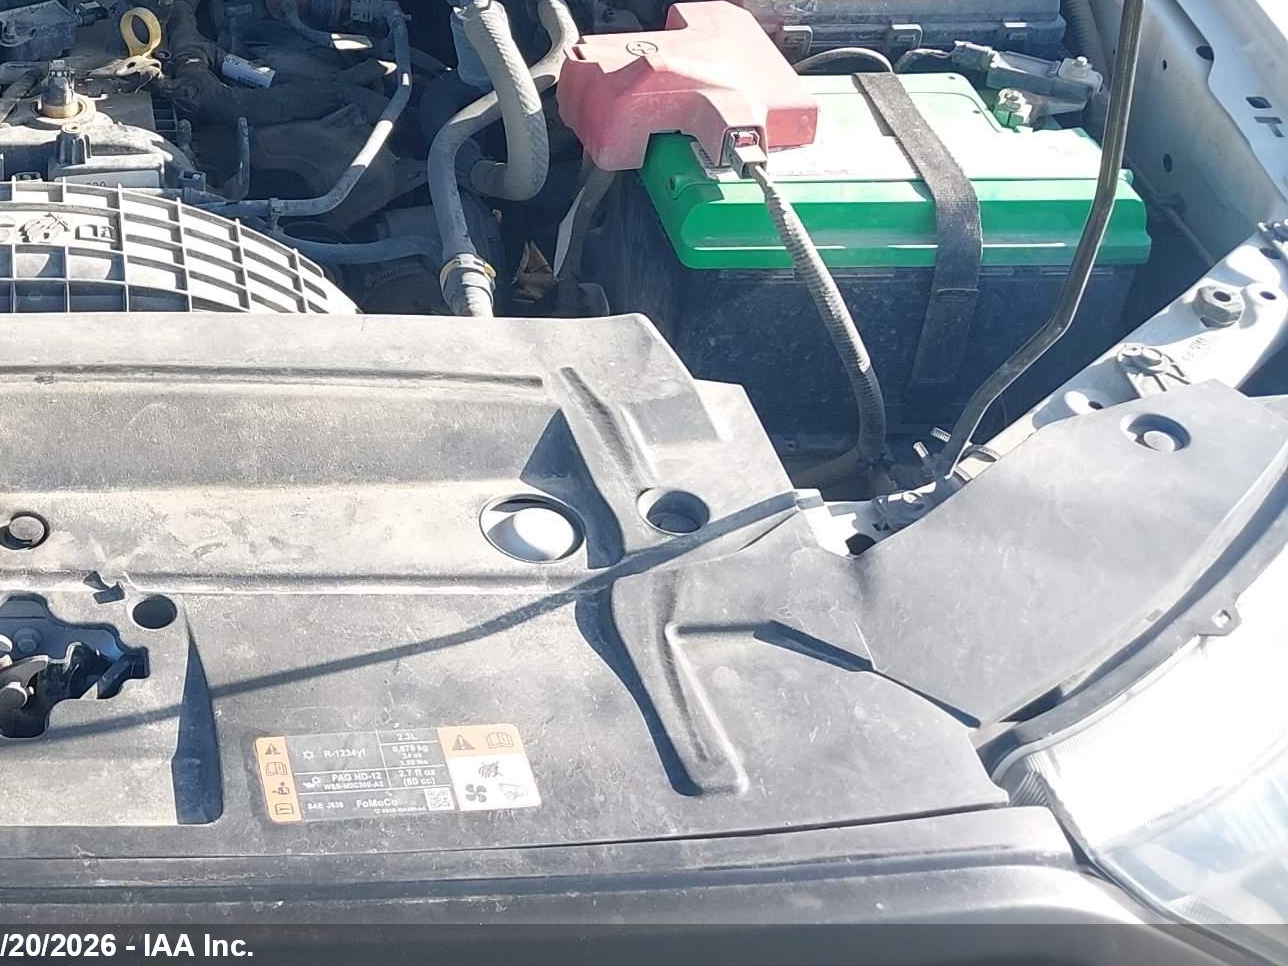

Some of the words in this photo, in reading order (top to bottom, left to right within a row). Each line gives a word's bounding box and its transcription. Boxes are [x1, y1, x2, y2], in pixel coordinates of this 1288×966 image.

[396, 732, 418, 742] 2.3L
[323, 747, 367, 760] R-1234yf
[331, 773, 352, 783] PAG
[354, 772, 382, 782] ND-12
[356, 797, 399, 809] FoMoCo
